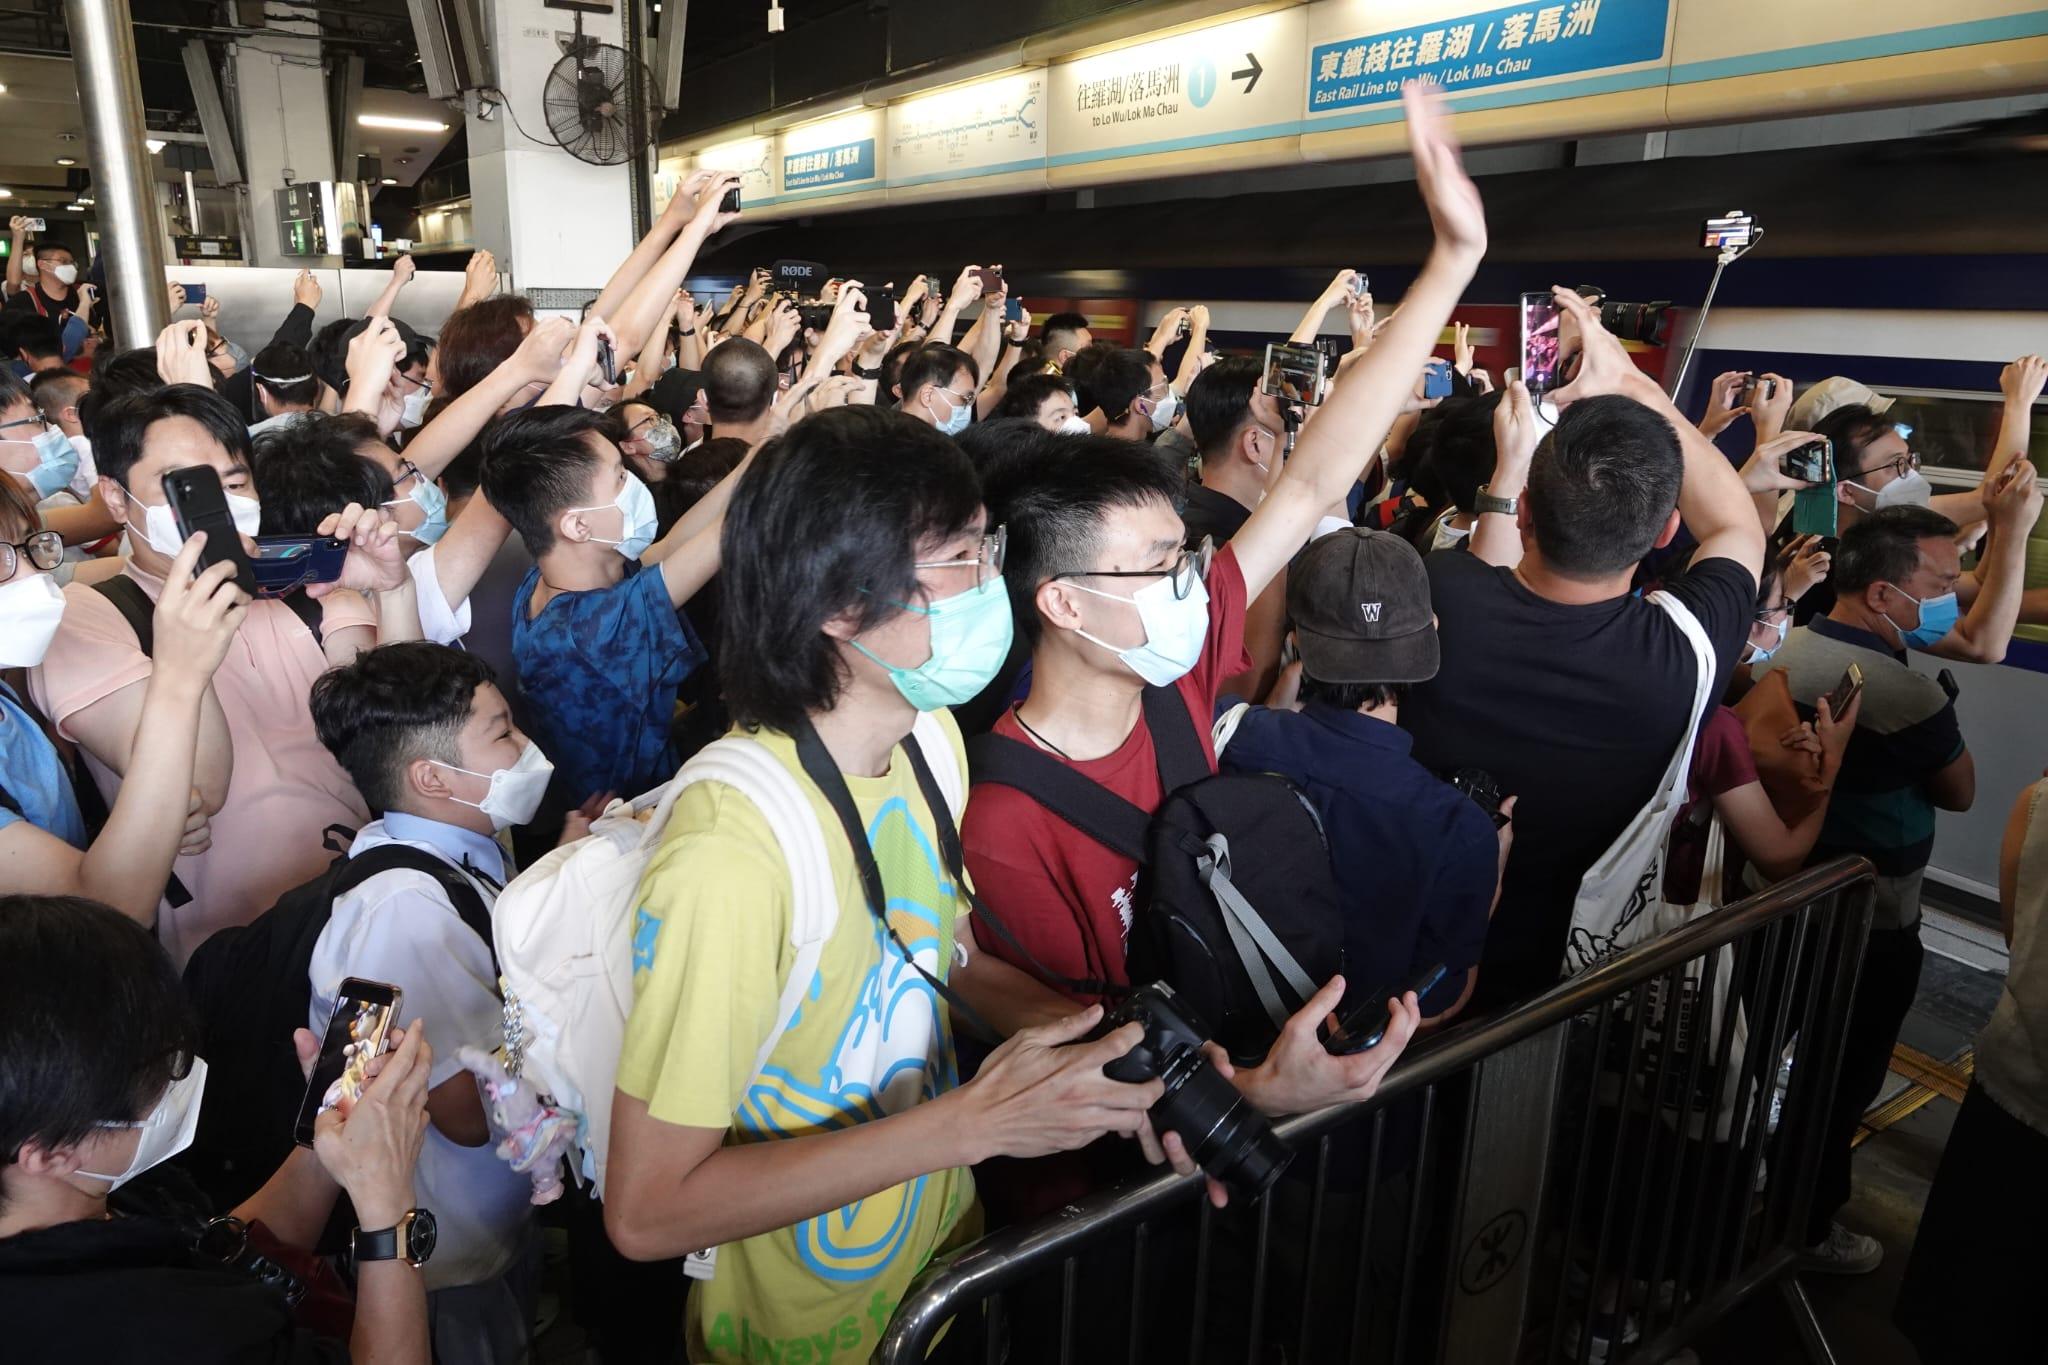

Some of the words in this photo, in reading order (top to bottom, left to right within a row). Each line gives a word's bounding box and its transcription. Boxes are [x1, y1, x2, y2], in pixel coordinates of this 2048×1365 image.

[1316, 23, 1476, 82] 東鐵綫往羅湖
[1496, 0, 1600, 51] 落馬洲
[1315, 90, 1337, 104] East
[1338, 83, 1359, 100] Rail
[1360, 81, 1384, 97] Line
[1386, 80, 1398, 92] to
[1418, 71, 1438, 87] Wu
[1446, 66, 1470, 84] Lok
[1472, 63, 1492, 79] Ma
[1495, 57, 1531, 75] Chau
[1092, 116, 1101, 127] to
[1102, 113, 1111, 125] Lo
[1143, 105, 1155, 118] Ma
[1156, 102, 1179, 116] Chau
[781, 265, 813, 277] RØDE
[1361, 602, 1382, 622] W
[707, 1310, 863, 1365] Always
